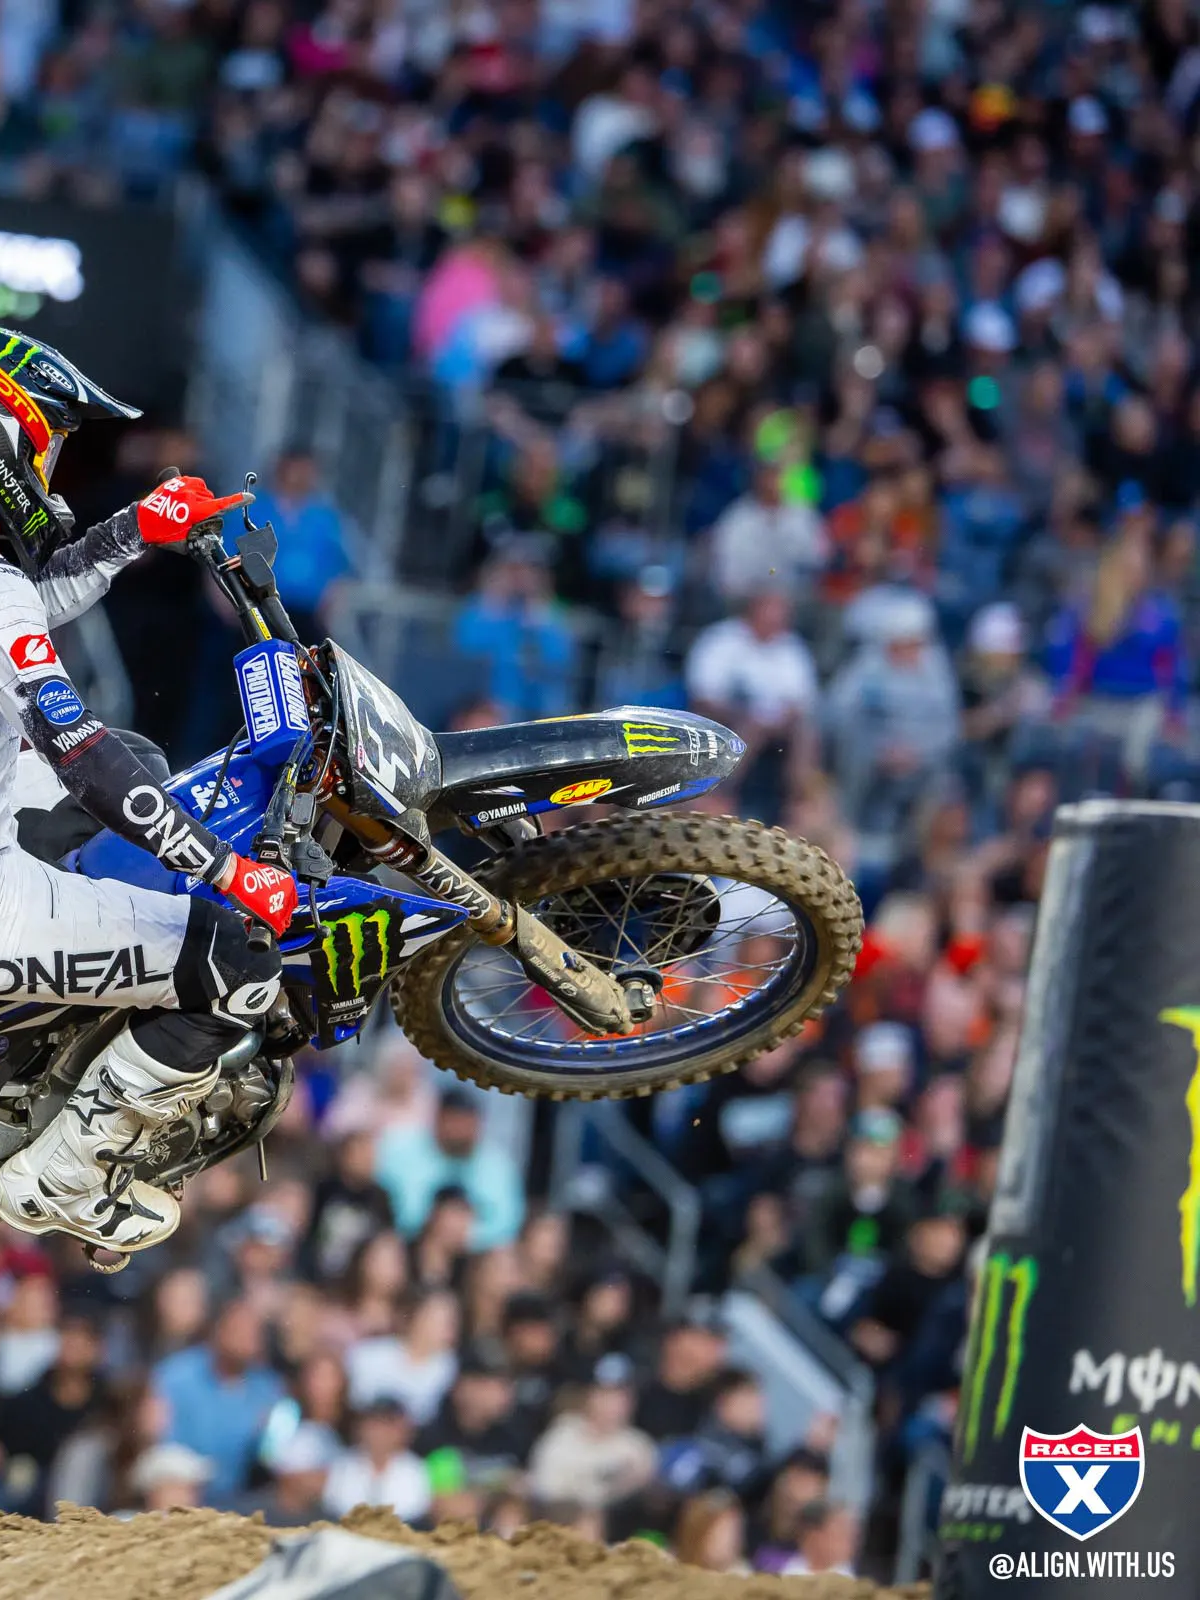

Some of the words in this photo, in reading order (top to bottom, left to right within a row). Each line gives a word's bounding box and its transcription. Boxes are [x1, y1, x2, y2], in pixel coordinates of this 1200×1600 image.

[246, 656, 278, 740] PROTAPER
[553, 779, 612, 803] FMF
[637, 783, 681, 806] PROGRESSIVE
[488, 802, 527, 820] YAMAHA
[268, 890, 285, 914] 32
